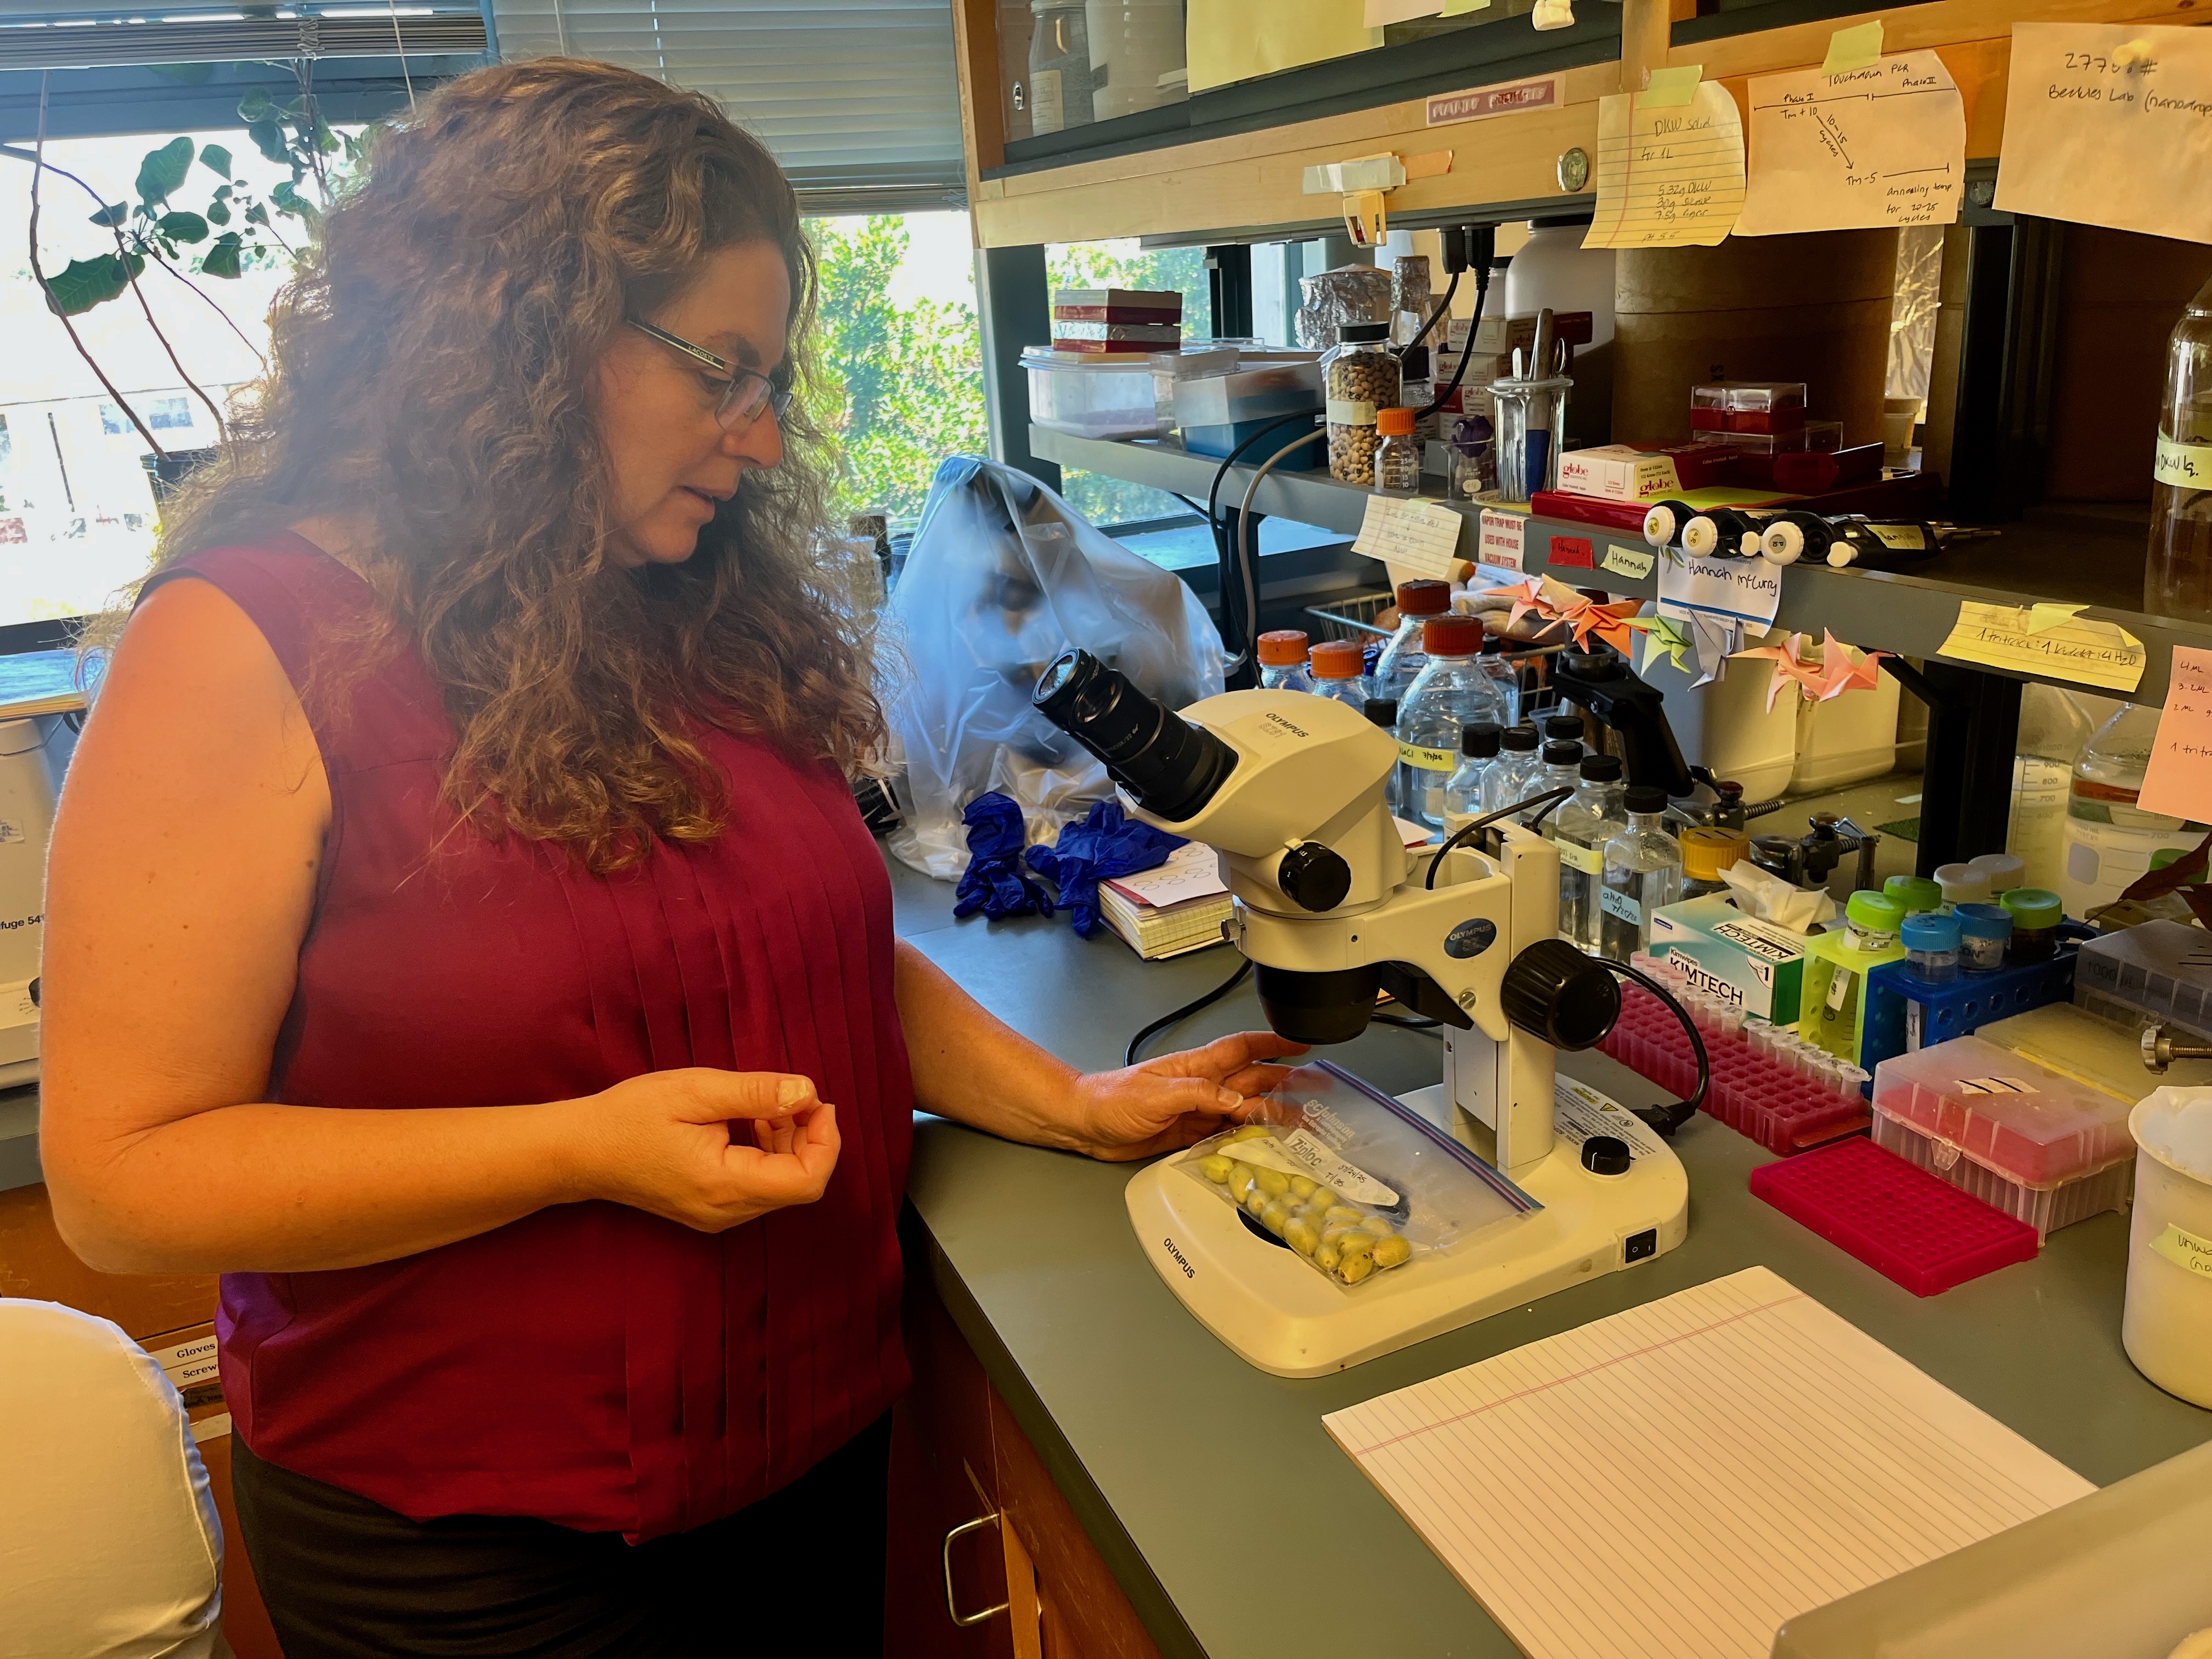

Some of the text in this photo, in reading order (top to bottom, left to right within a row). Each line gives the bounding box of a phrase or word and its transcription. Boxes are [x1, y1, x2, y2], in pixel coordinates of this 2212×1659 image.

[1891, 63, 1909, 74] PCR
[2109, 87, 2134, 102] Lab
[1810, 106, 1818, 116] 10
[1655, 117, 1682, 137] DKW
[1688, 180, 1712, 194] DKW
[1656, 197, 1675, 213] 30g
[1562, 462, 1589, 479] globe
[1639, 478, 1674, 498] globe
[1482, 515, 1522, 531] VAPOR TRAP MUST BE
[1485, 534, 1519, 550] USED WITH HOUSE
[1485, 552, 1516, 568] VACUUM SYSTEM
[1612, 550, 1647, 572] Hannah
[1688, 558, 1777, 597] Hannah McCurry
[2180, 661, 2190, 669] 4
[1266, 713, 1309, 737] OLYMPUS
[2170, 742, 2176, 752] 1
[1449, 924, 1492, 941] OLYMPUS
[1713, 926, 1789, 960] KIMTECH
[1671, 947, 1698, 967] Kimwipes
[1670, 957, 1743, 1006] KIMTECH
[1764, 967, 1769, 981] 1
[1290, 1138, 1322, 1166] Ziploc
[1338, 1164, 1367, 1183] 07/24/25
[1164, 1238, 1195, 1279] OLYMPUS
[177, 1344, 216, 1358] Gloves
[183, 1364, 217, 1378] Screw
